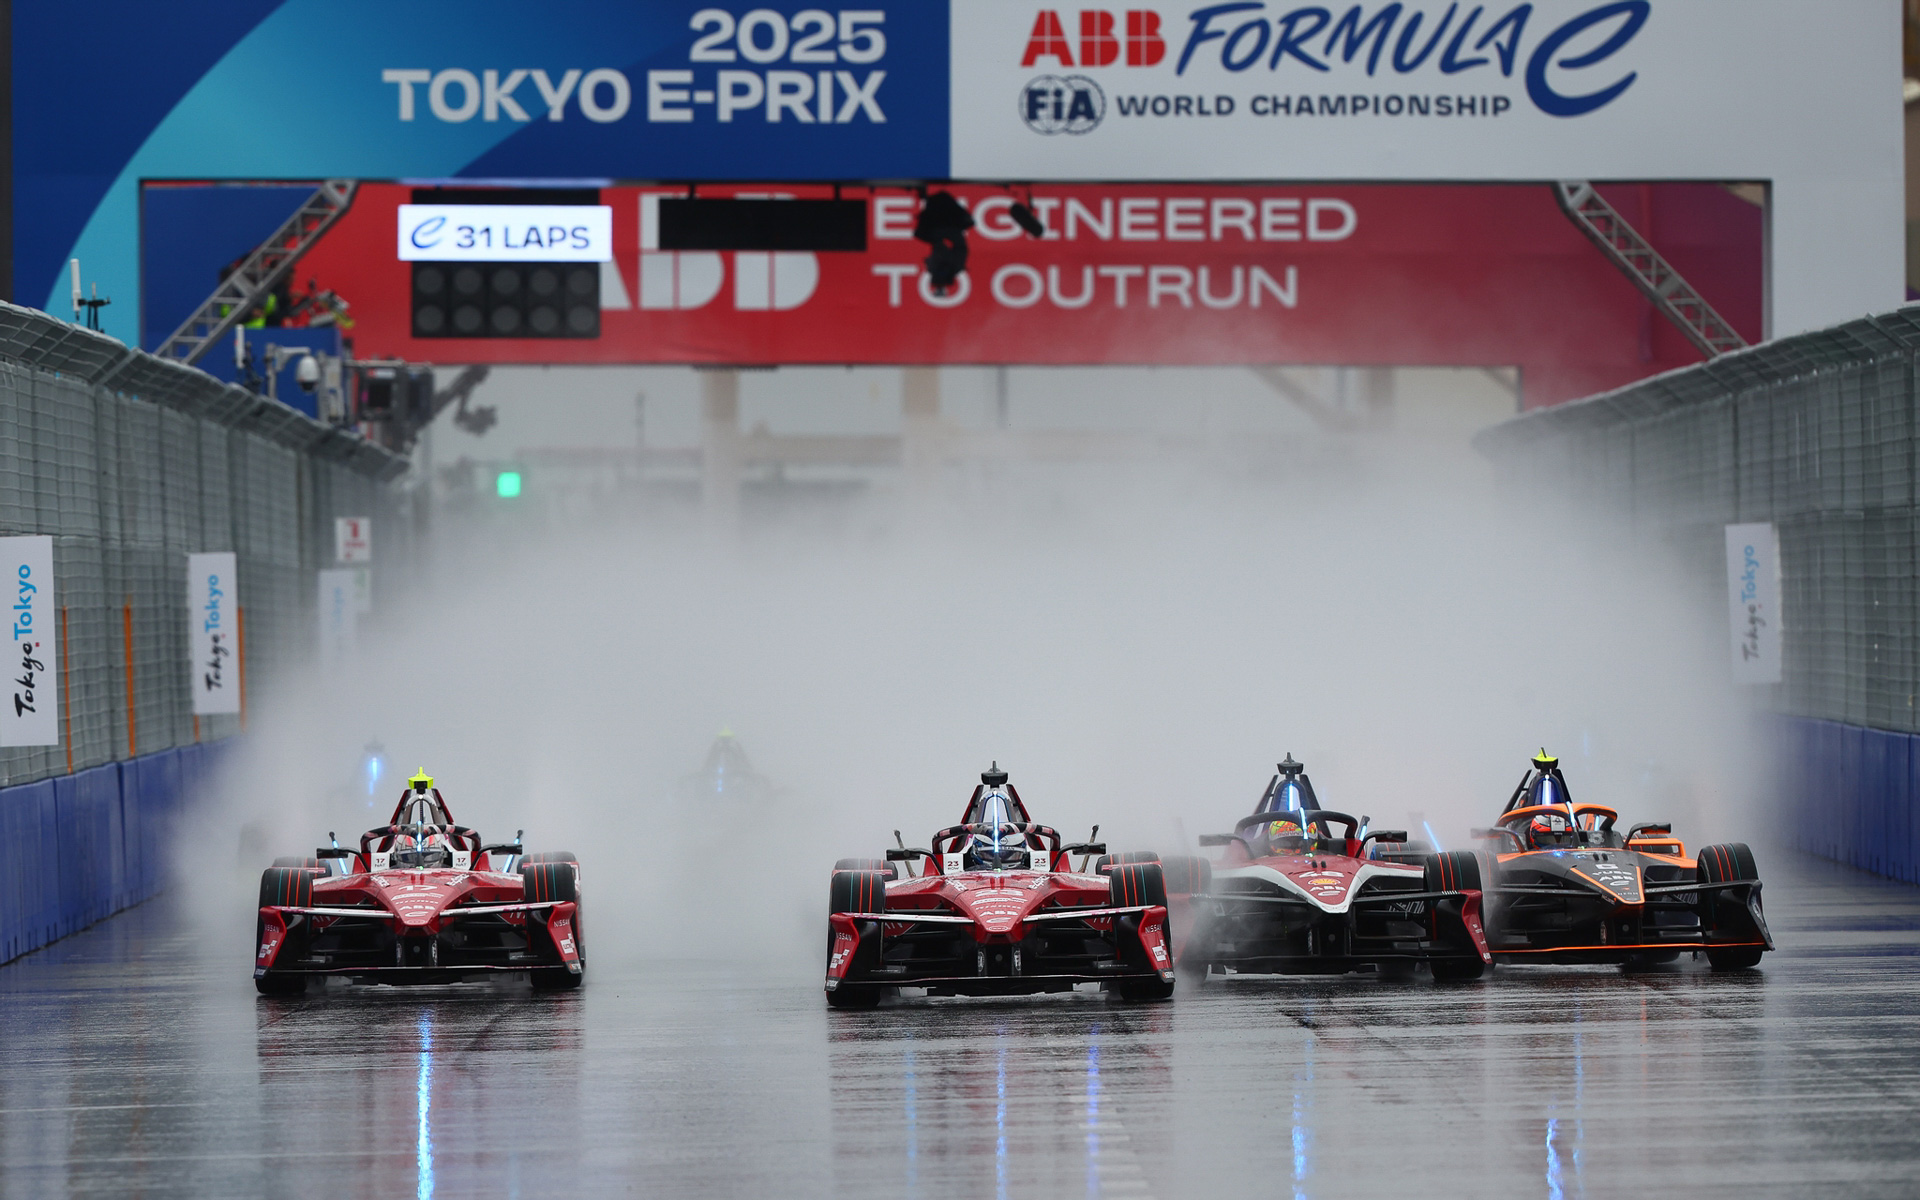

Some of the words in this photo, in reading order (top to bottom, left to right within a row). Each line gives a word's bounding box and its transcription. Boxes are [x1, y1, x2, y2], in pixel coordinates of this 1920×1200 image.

[689, 9, 886, 63] 2025
[1020, 10, 1166, 67] ABB
[1176, 2, 1533, 77] FORMULA
[382, 68, 631, 122] TOKYO
[648, 70, 887, 123] E-PRIX
[1117, 95, 1235, 116] WORLD
[1250, 95, 1511, 116] CHAMPIONSHIP
[456, 226, 493, 249] 31
[504, 226, 590, 249] LAPS
[874, 197, 1357, 240] EGINEERED
[872, 265, 971, 308] TO
[991, 264, 1298, 308] OUTRUN
[14, 564, 38, 640] Tokyo
[1741, 545, 1760, 603] Tokyo
[204, 574, 224, 633] Tokyo
[15, 641, 44, 718] Tokyo
[205, 634, 229, 691] Tokyo
